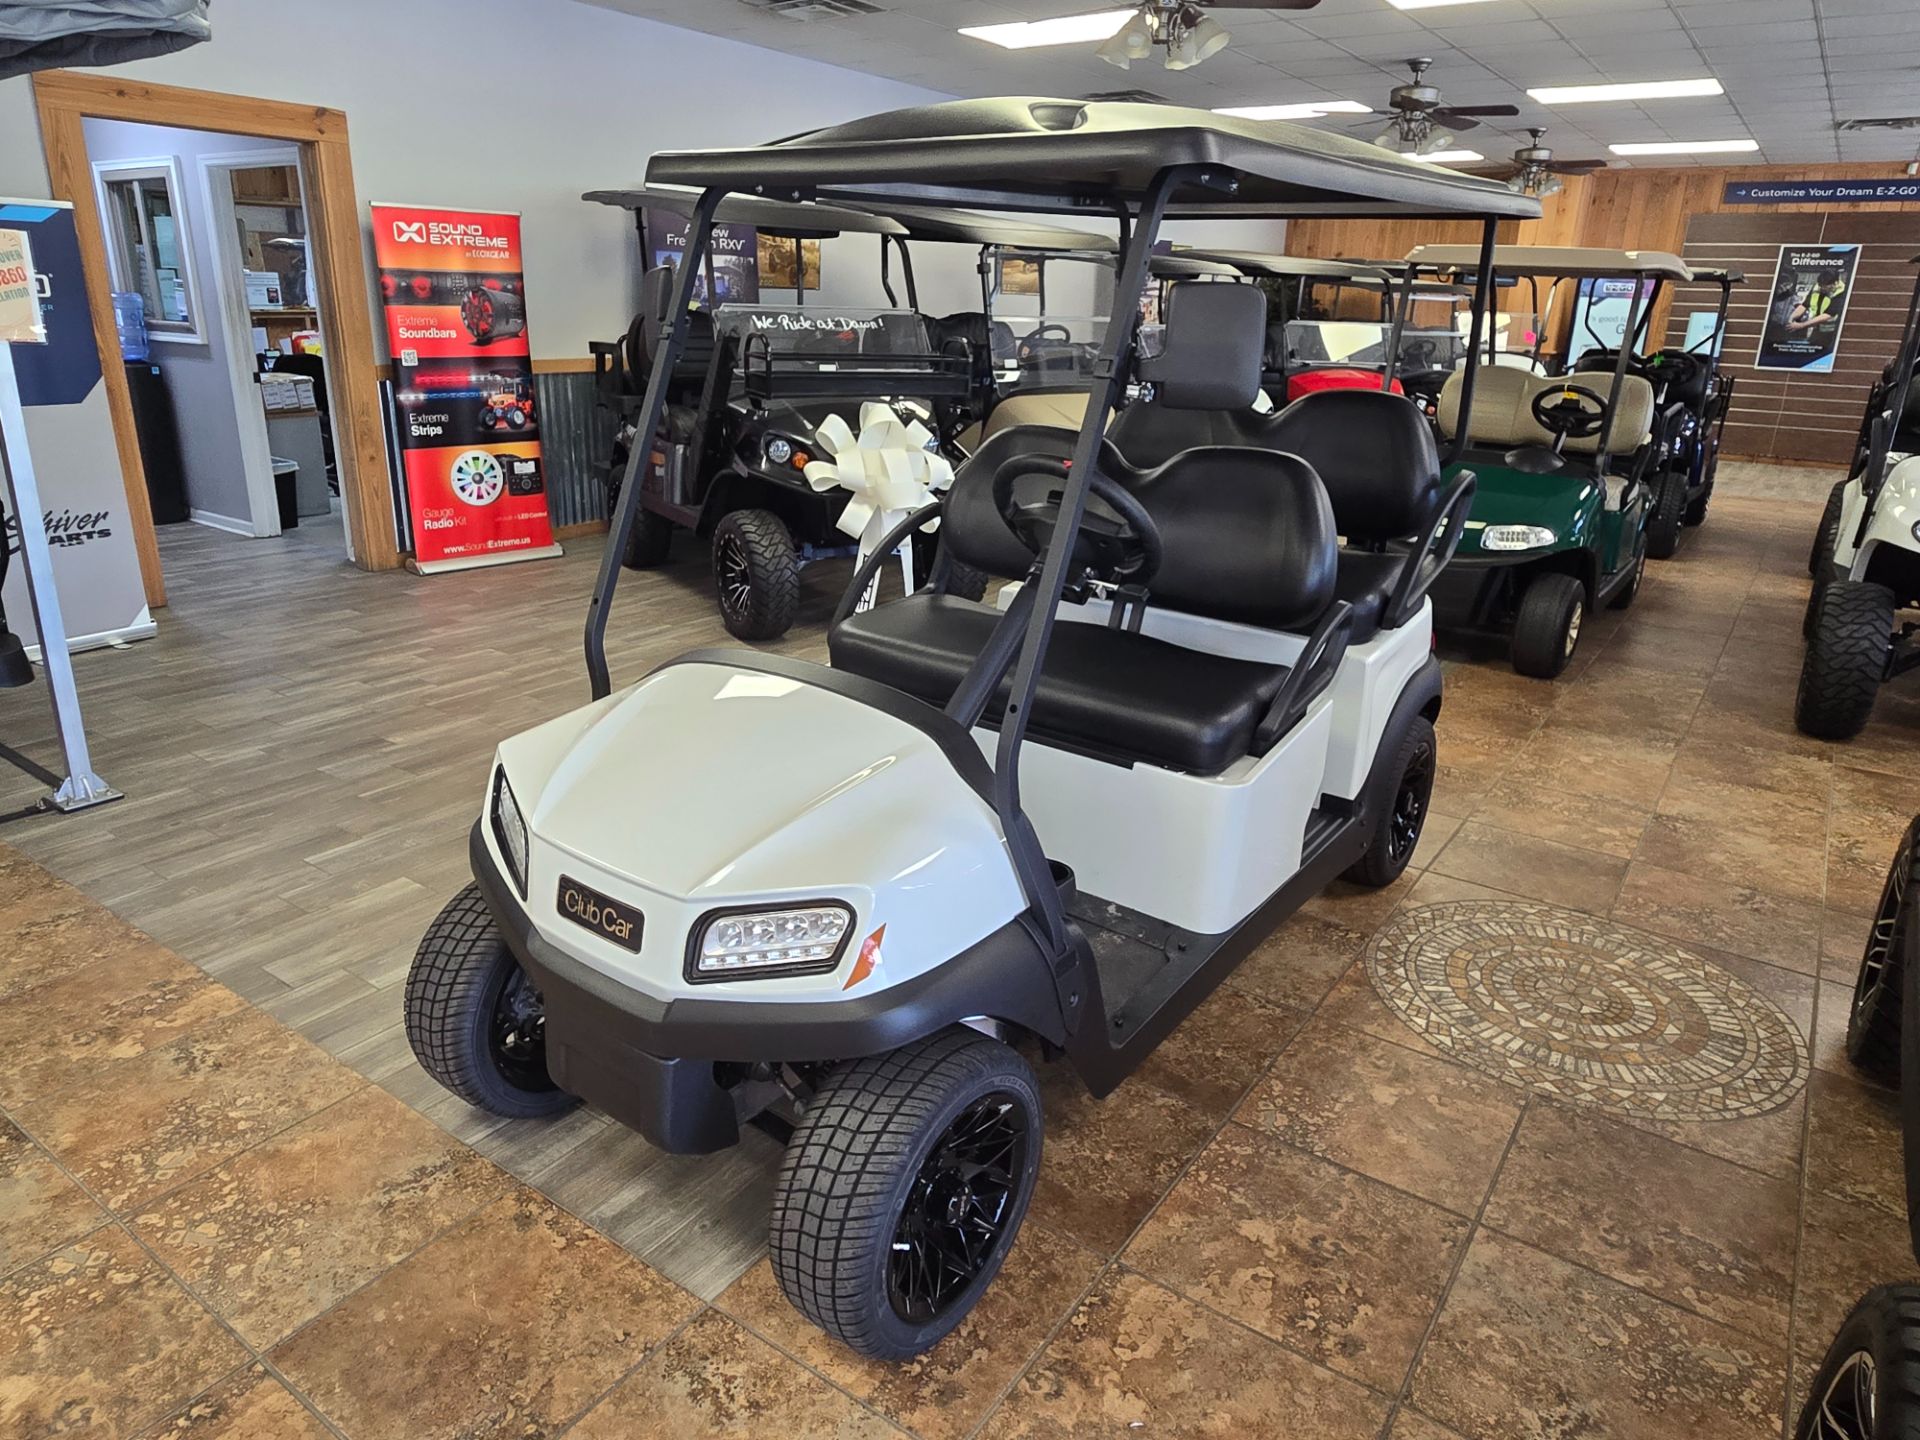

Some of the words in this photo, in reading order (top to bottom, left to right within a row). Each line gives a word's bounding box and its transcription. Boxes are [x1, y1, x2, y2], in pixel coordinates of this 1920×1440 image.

[1750, 188, 1806, 198] Customize
[1808, 187, 1834, 197] Your
[1836, 186, 1873, 196] Dream
[1876, 186, 1918, 196] E-Z-GO
[429, 222, 482, 236] SOUND
[430, 233, 509, 248] EXTREME
[1791, 257, 1844, 266] Difference
[0, 266, 27, 286] 860
[397, 314, 438, 326] Extreme
[751, 315, 778, 329] We
[778, 314, 815, 330] Ride
[816, 318, 836, 330] at
[835, 316, 886, 331] Dawn!
[399, 327, 457, 339] Soundbars
[409, 413, 449, 424] Extreme
[410, 424, 443, 438] Strips
[422, 507, 455, 519] Gauge
[423, 518, 454, 531] Radio
[454, 516, 467, 527] Kit
[47, 528, 112, 546] ARTS
[564, 889, 601, 925] Club
[602, 907, 634, 940] Car
